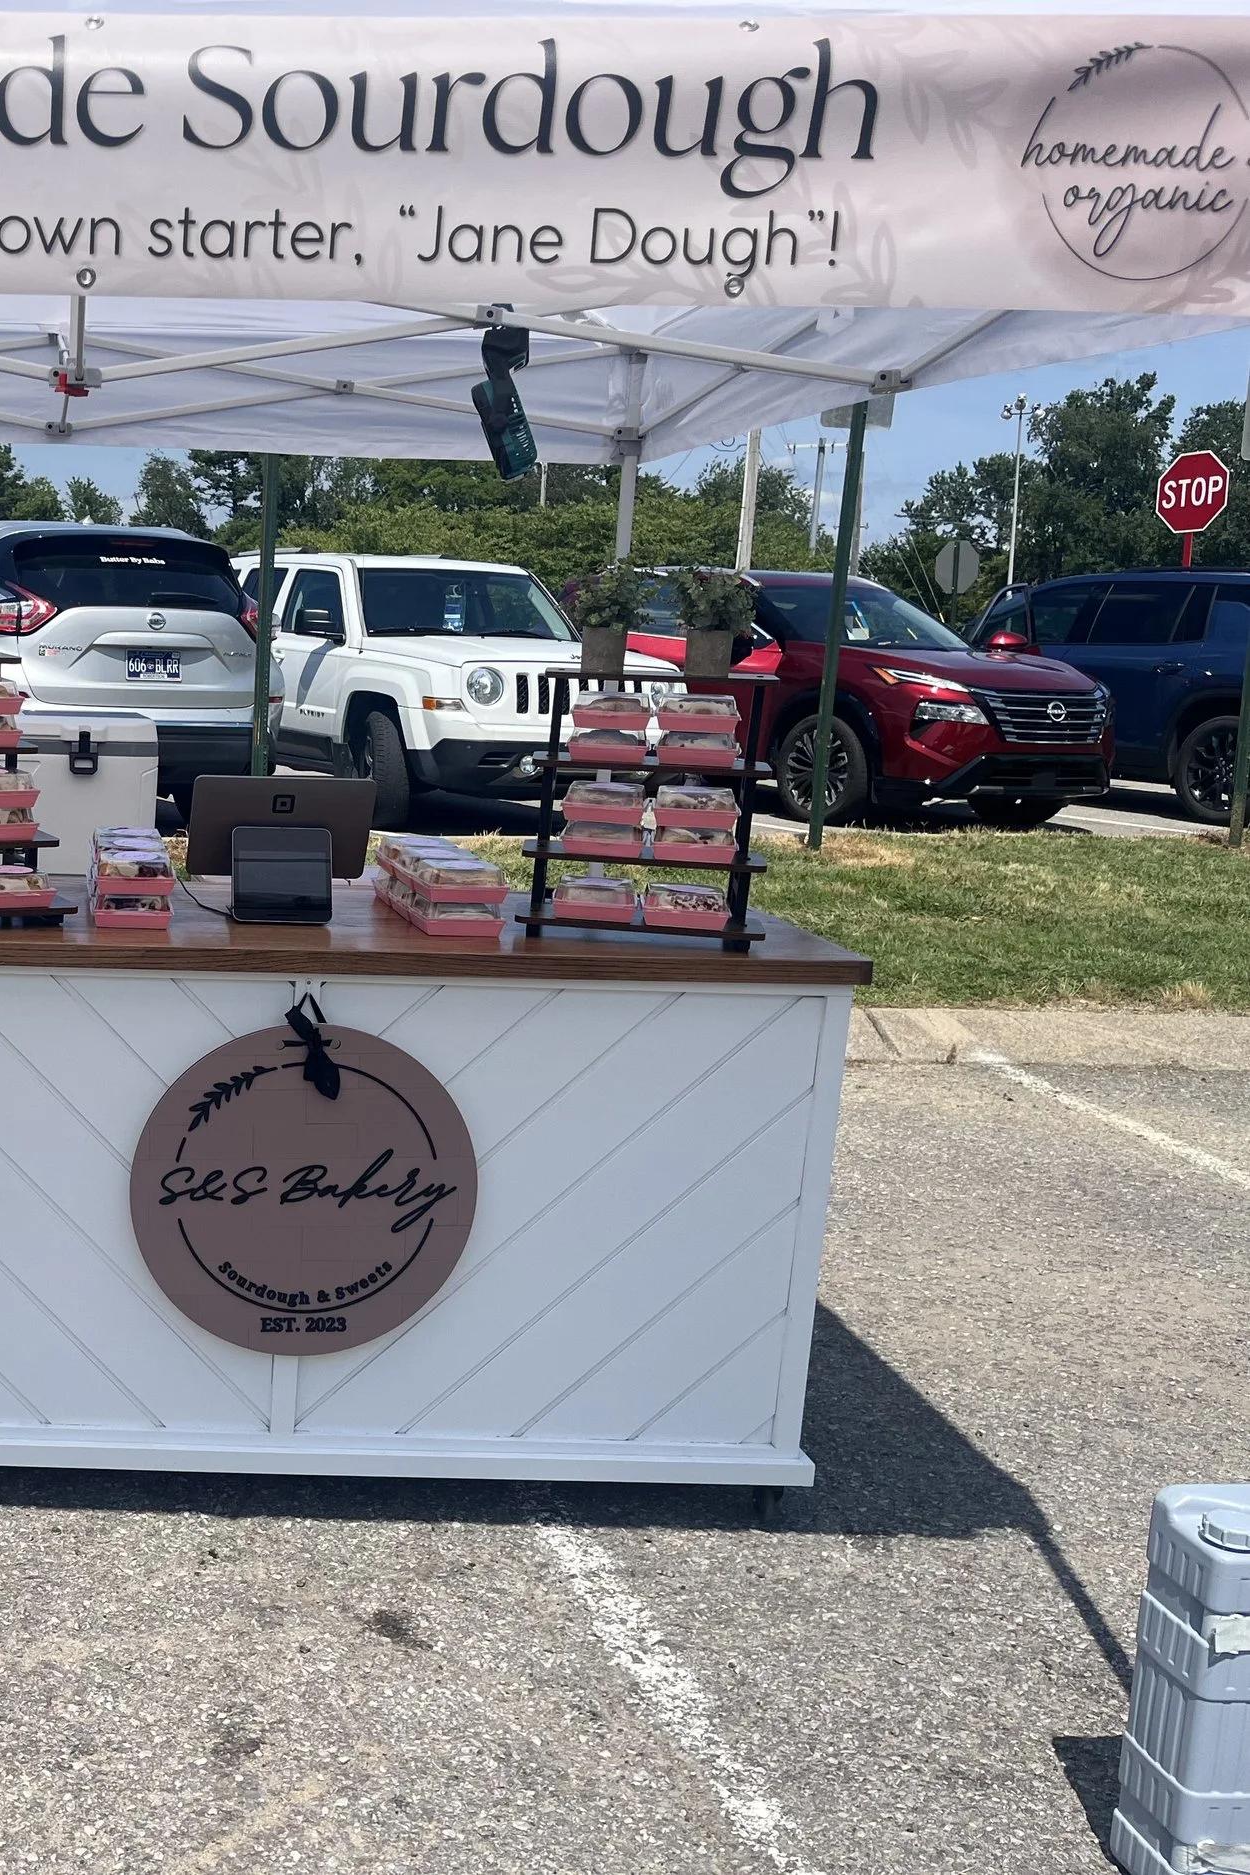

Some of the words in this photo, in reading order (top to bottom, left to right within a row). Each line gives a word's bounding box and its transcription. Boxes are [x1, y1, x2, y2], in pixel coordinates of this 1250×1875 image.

[182, 37, 880, 199] Sourdough
[1020, 96, 1237, 172] homemade
[147, 206, 363, 267] starter,
[399, 204, 564, 265] “Jane
[589, 207, 840, 276] Dough”!
[1063, 181, 1234, 258] organic
[1161, 475, 1224, 509] STOP
[129, 557, 142, 565] By
[128, 658, 147, 673] 606
[155, 658, 179, 674] BLRR
[158, 1165, 268, 1206] S&S
[279, 1148, 457, 1234] Bakery
[217, 1260, 311, 1308] Sourdough
[316, 1289, 331, 1303] &
[335, 1259, 394, 1301] Sweets
[260, 1316, 301, 1333] EST.
[305, 1316, 347, 1333] 2023
